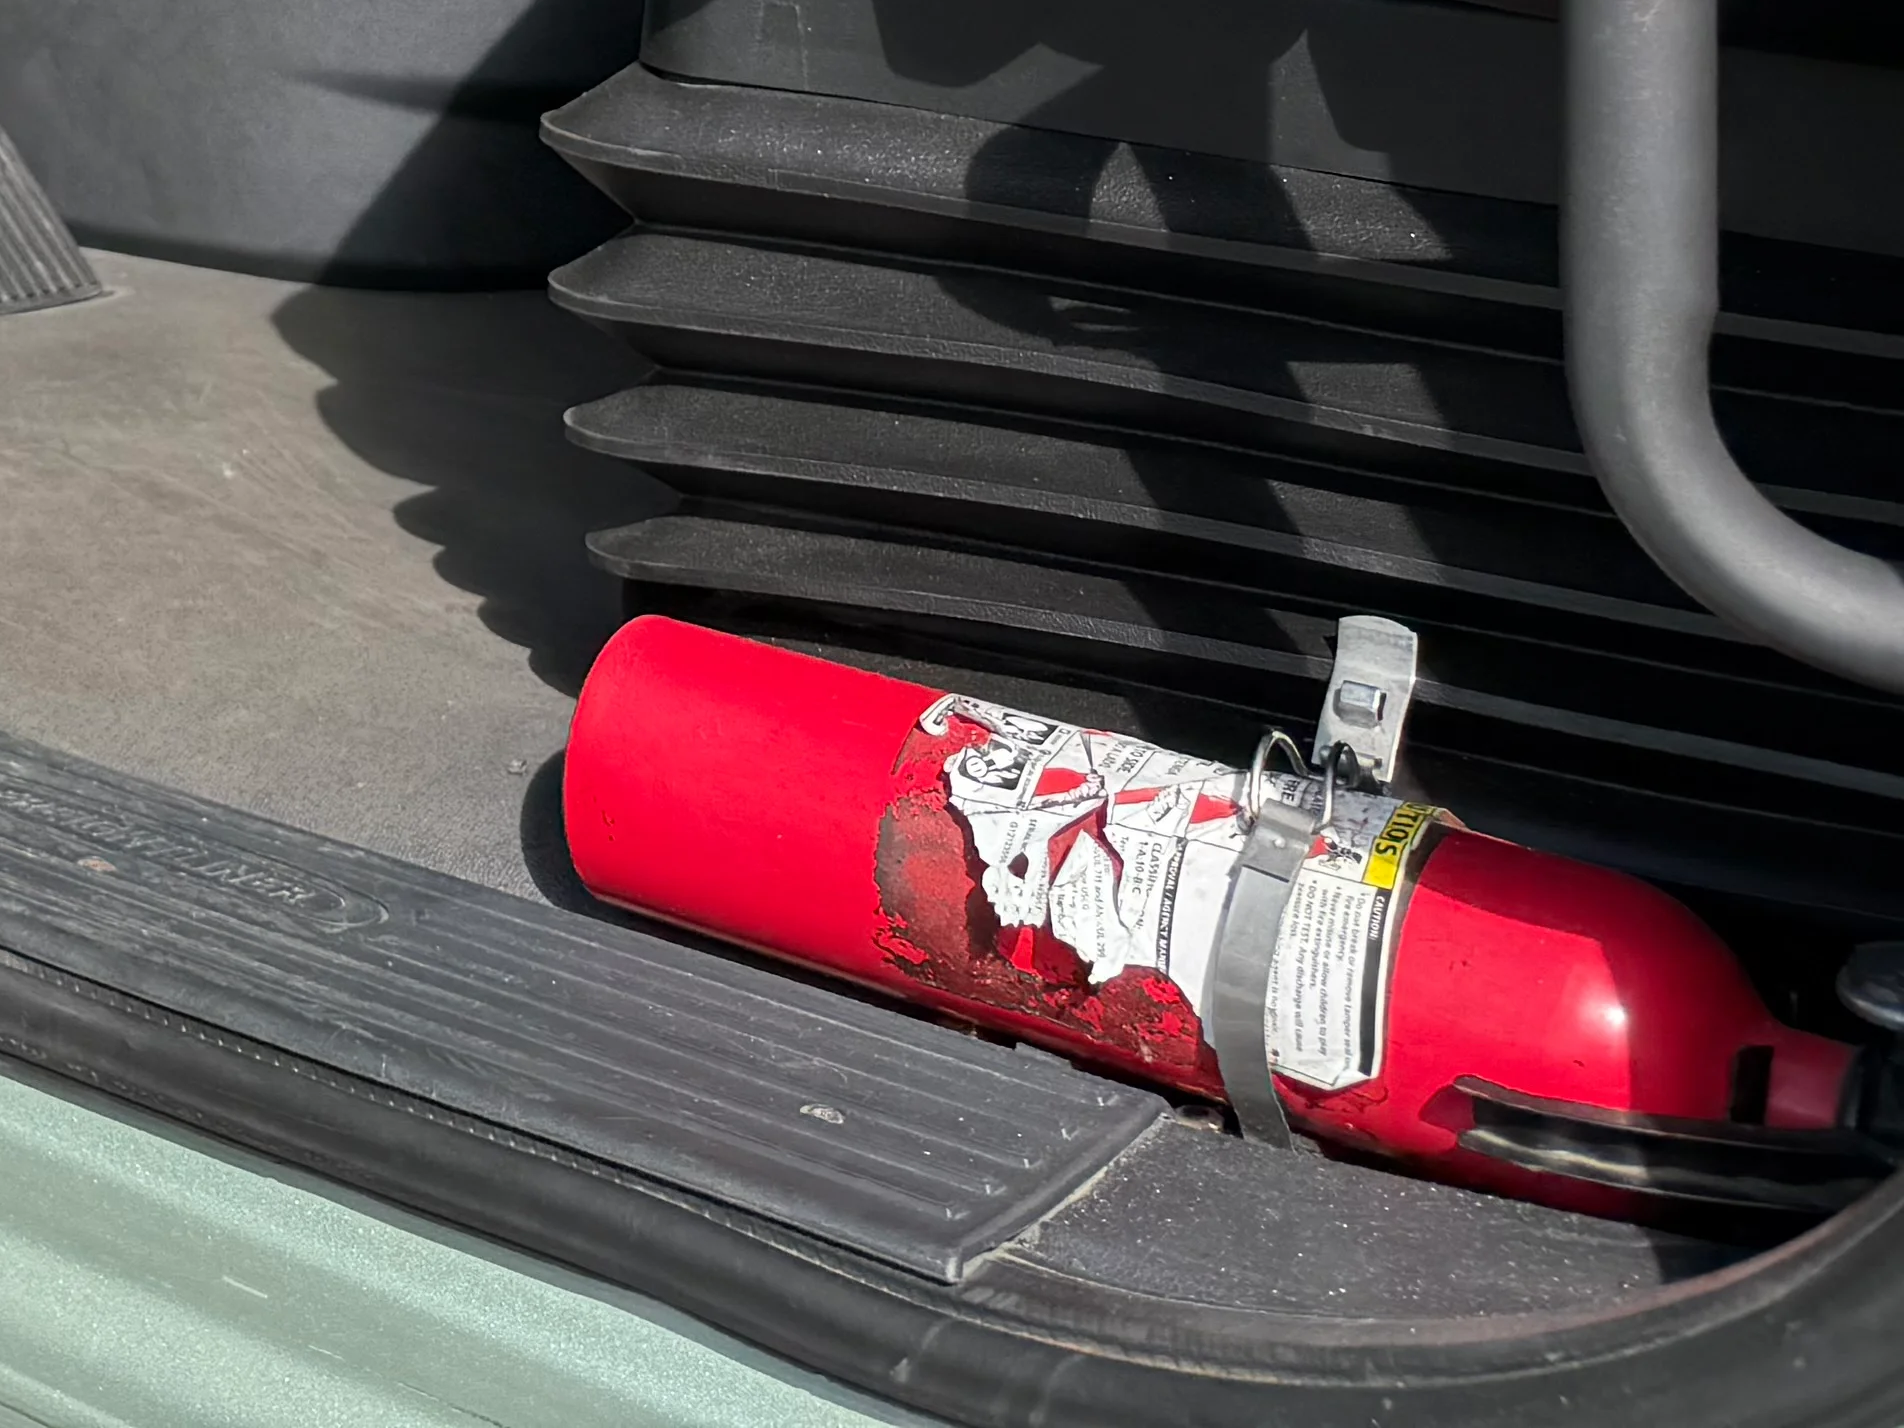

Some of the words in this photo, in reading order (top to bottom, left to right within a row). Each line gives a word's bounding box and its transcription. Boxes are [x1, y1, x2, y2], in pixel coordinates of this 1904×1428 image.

[1091, 885, 1102, 902] and
[1306, 885, 1316, 899] DO
[1319, 888, 1329, 908] with
[1343, 895, 1352, 909] fire
[1303, 900, 1314, 920] NOT
[1329, 891, 1340, 916] Never
[1355, 897, 1365, 909] Do
[1159, 897, 1171, 937] AGENCY
[1317, 910, 1326, 926] fire
[1324, 918, 1335, 949] misuse
[1348, 928, 1359, 954] break
[1294, 946, 1307, 964] Any
[1308, 927, 1322, 990] extinguishers.
[1323, 950, 1329, 959] or
[1347, 956, 1354, 966] or
[1320, 961, 1330, 987] allow
[1291, 966, 1304, 1009] discharge
[1344, 968, 1353, 1001] remove
[1318, 988, 1327, 1024] children
[1342, 1003, 1352, 1036] tamper
[1319, 1026, 1326, 1035] to
[1318, 1038, 1327, 1056] play
